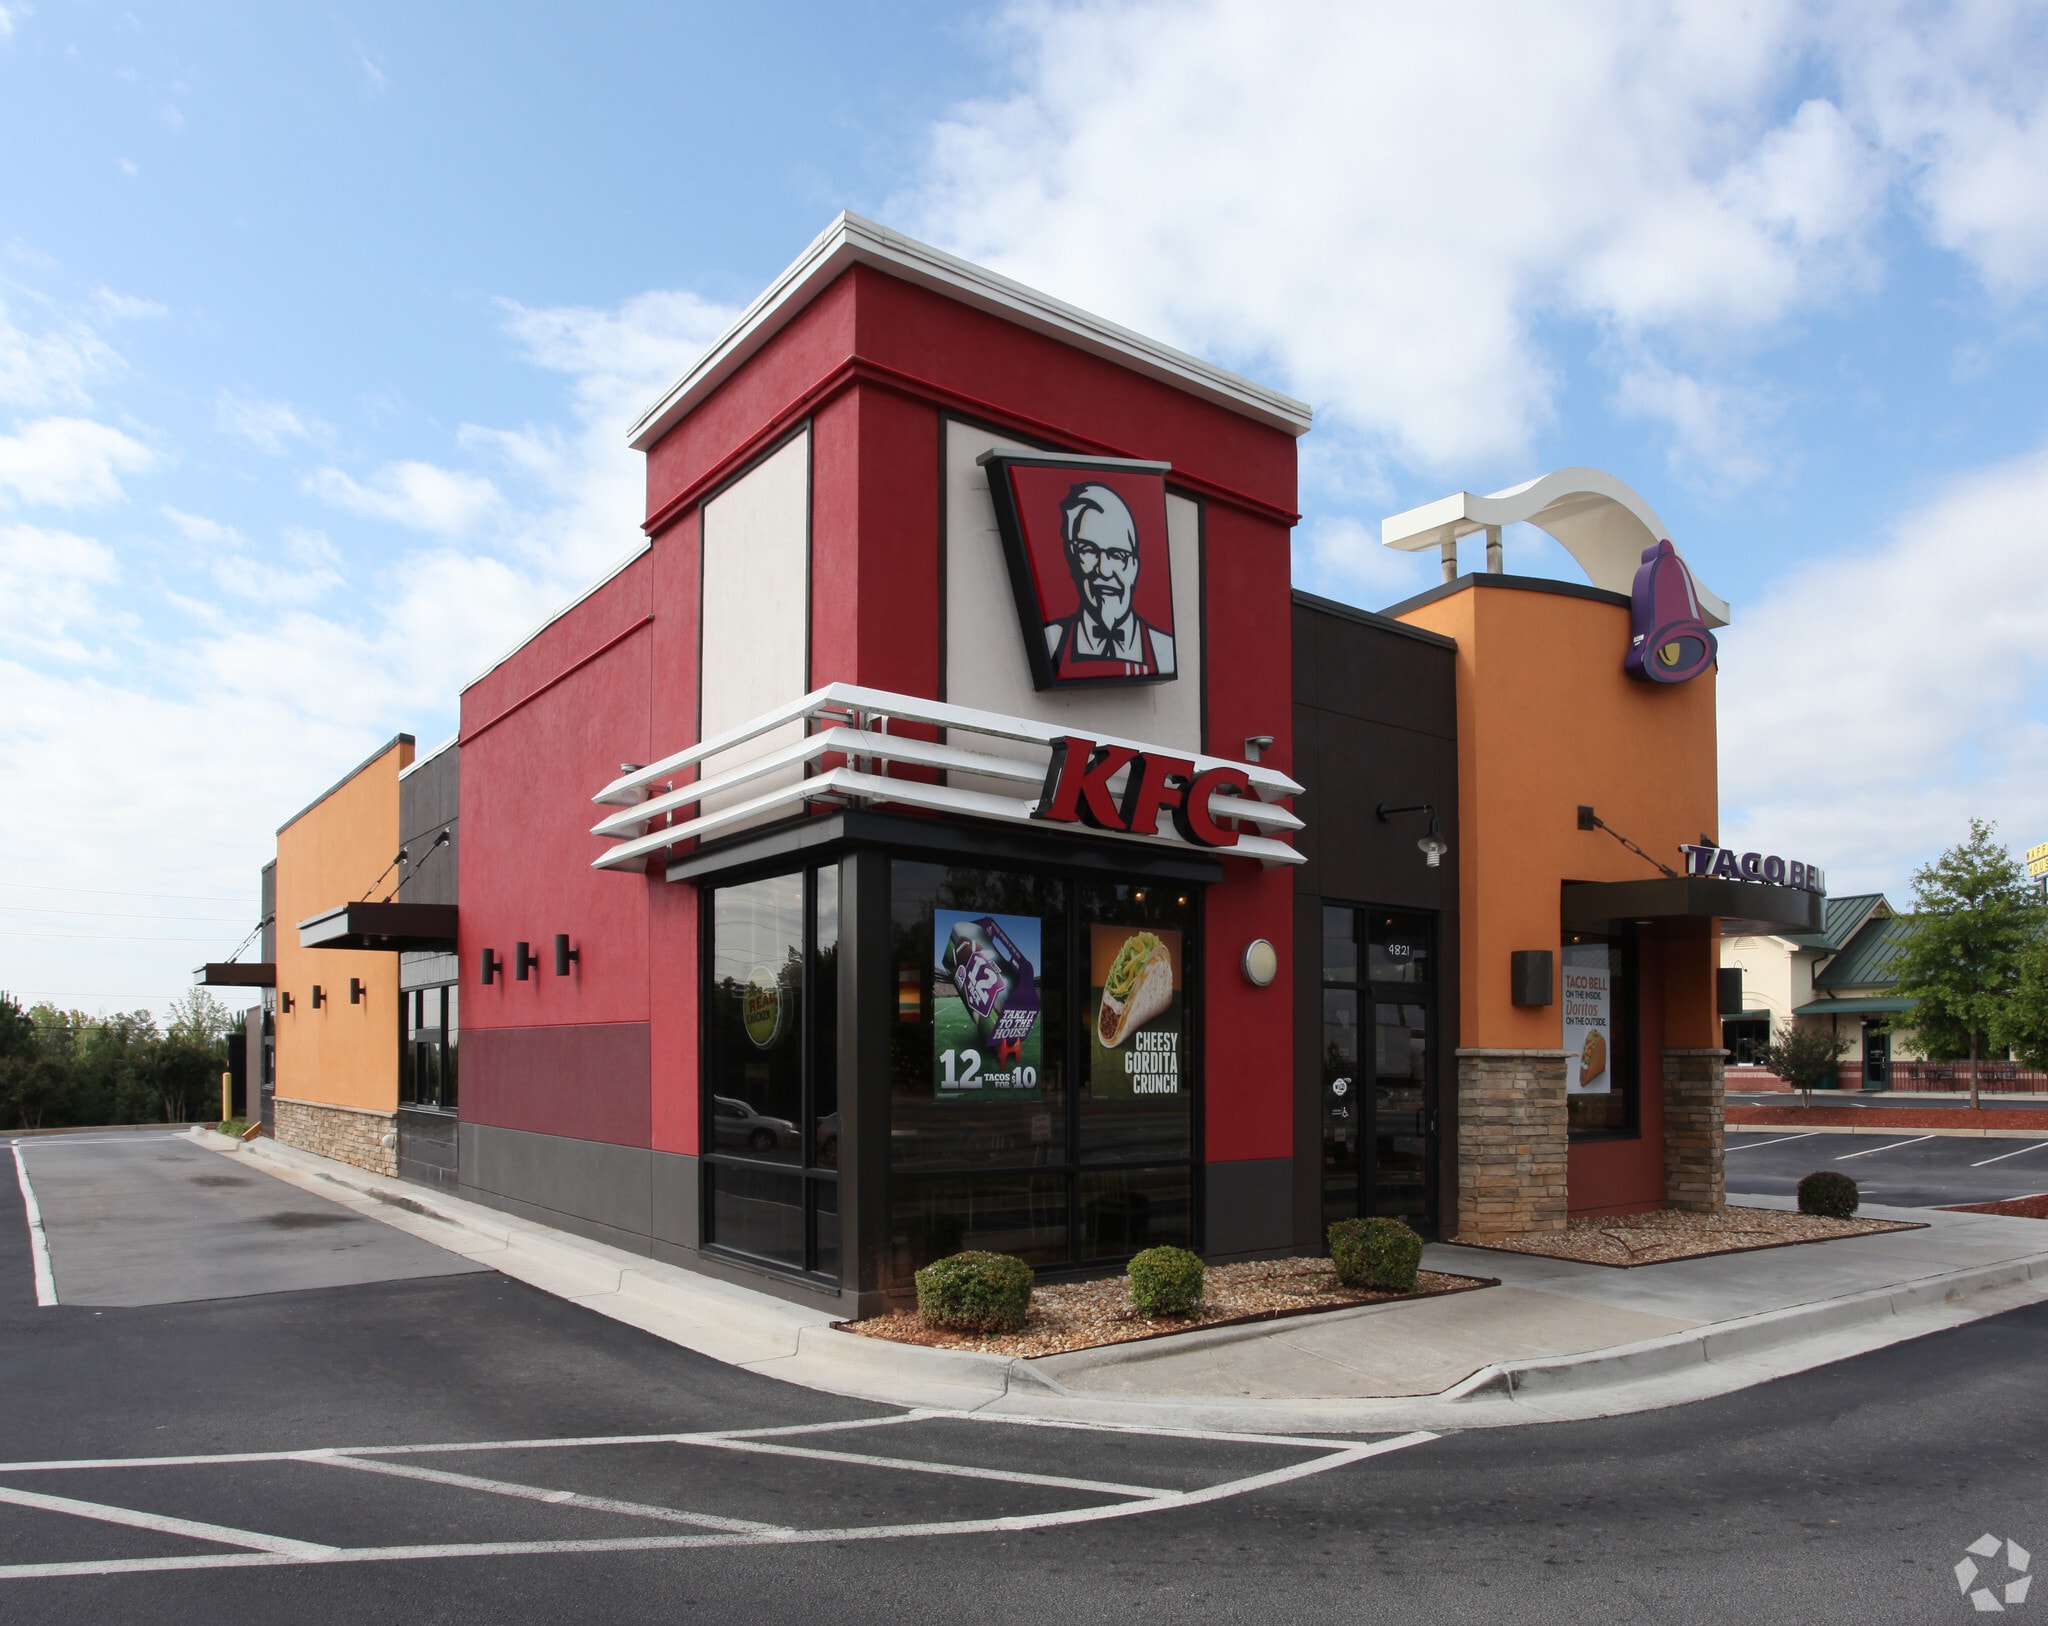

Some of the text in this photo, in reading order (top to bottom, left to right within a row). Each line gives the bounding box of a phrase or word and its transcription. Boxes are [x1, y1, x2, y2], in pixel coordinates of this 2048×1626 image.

[1030, 735, 1250, 848] KFC
[1679, 844, 1827, 897] TACO BELL
[1388, 944, 1410, 956] 4821
[968, 956, 998, 1006] 12
[1565, 974, 1607, 991] TACO BELL
[1565, 990, 1574, 999] ON
[1575, 990, 1585, 999] THE
[1003, 1009, 1037, 1020] TAKE IT
[1565, 1000, 1598, 1017] Doritos
[999, 1019, 1031, 1029] TO THE
[1565, 1017, 1574, 1025] ON
[1575, 1017, 1585, 1026] THE
[993, 1028, 1028, 1040] HOUSE
[1135, 1031, 1178, 1051] CHEESY
[939, 1048, 1037, 1089] 12 TACOS FOR $10
[1124, 1051, 1178, 1074] GORDITA
[1133, 1074, 1178, 1094] CRUNCH
